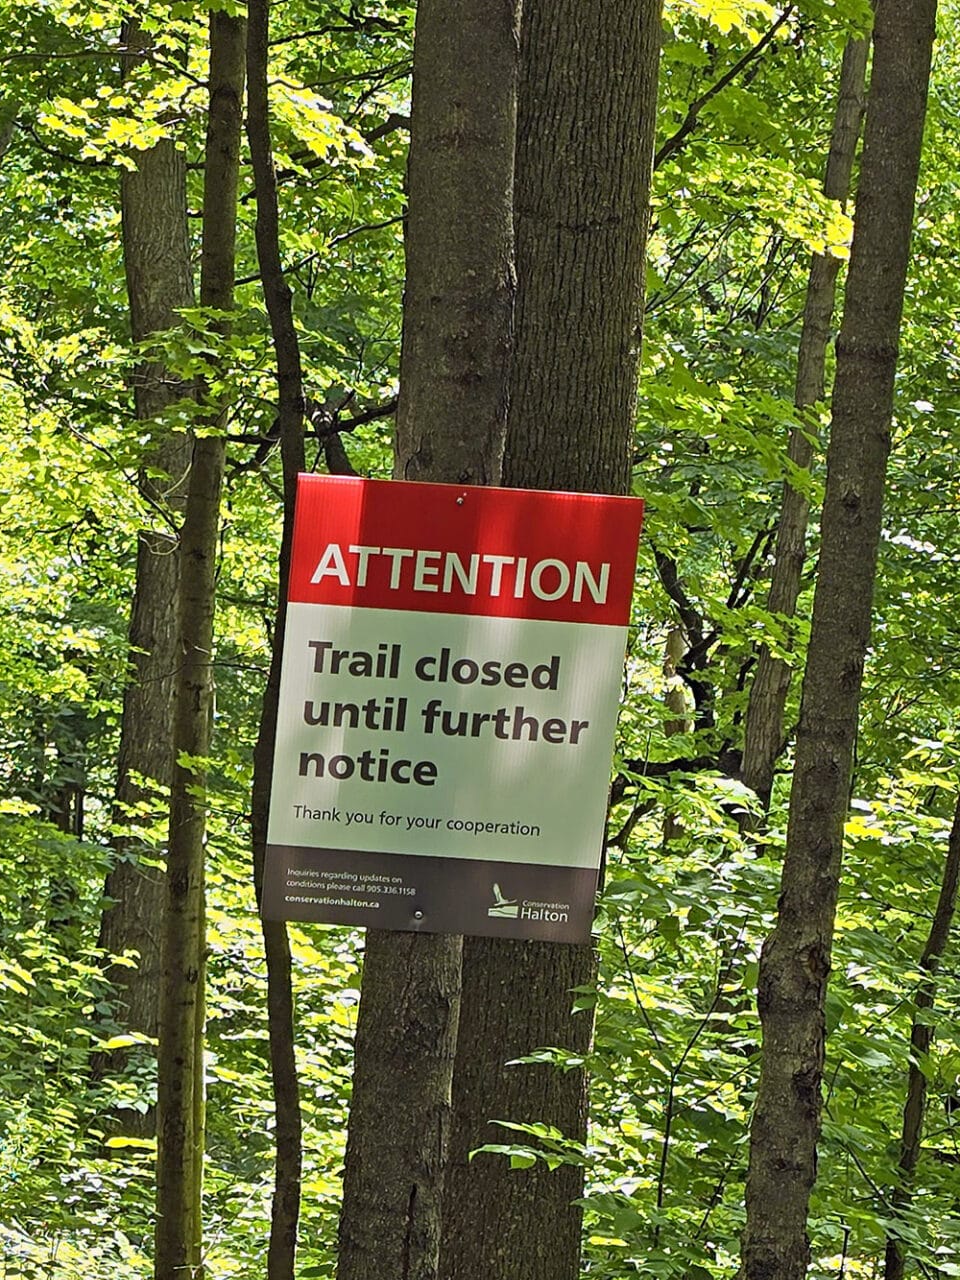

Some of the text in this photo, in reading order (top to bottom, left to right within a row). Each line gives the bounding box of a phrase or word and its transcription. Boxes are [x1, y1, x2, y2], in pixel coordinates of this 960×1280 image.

[311, 543, 610, 605] ATTENTION
[308, 640, 560, 690] Trail closed
[303, 697, 589, 744] until further
[298, 749, 438, 785] notice
[294, 805, 540, 836] Thank you for your cooperation
[287, 868, 319, 878] Inquiries
[321, 872, 357, 882] regarding
[359, 873, 389, 884] updates
[286, 880, 415, 896] conditions please call 905.336.1158
[285, 895, 380, 908] conservationhalton.ca
[522, 900, 569, 910] Conservation
[521, 908, 568, 922] Halton
